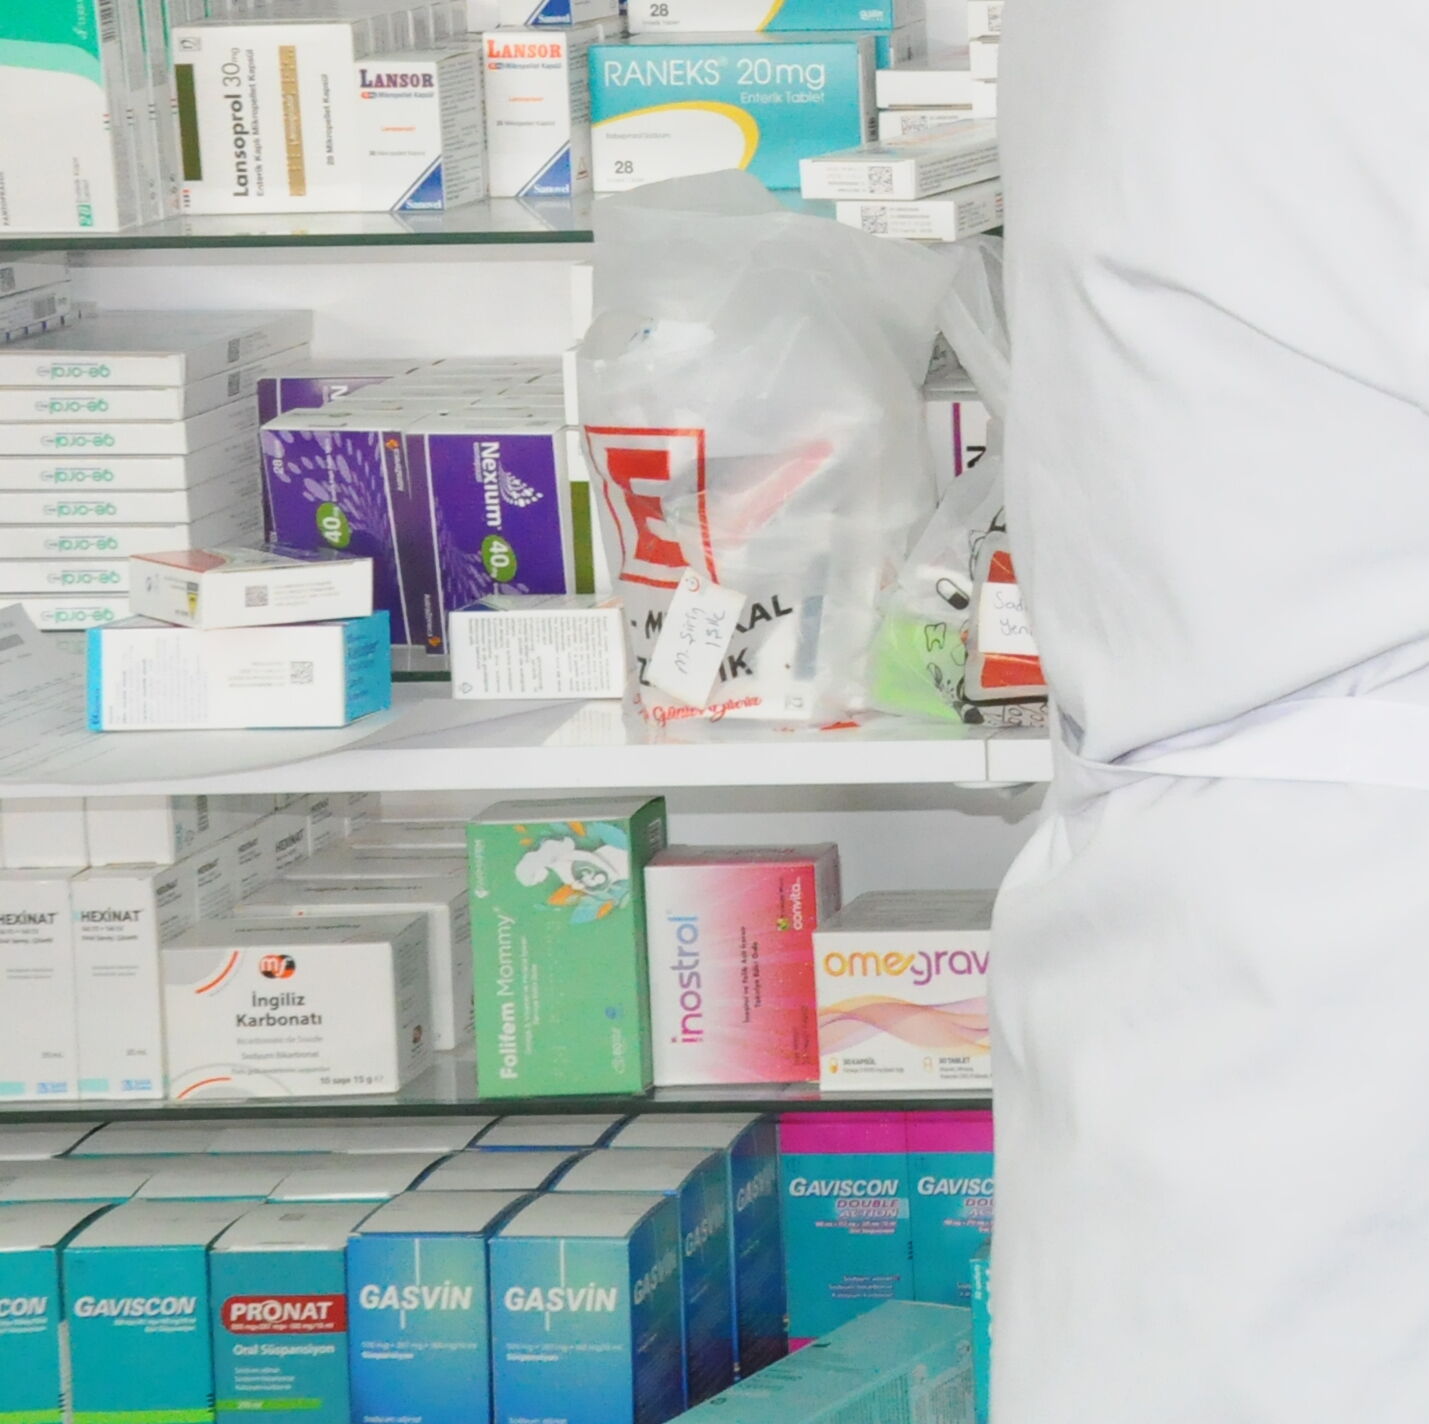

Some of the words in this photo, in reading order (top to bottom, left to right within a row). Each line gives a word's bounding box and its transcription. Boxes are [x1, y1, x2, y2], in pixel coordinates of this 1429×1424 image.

[649, 4, 669, 17] 28
[487, 39, 562, 60] LANSOR
[221, 47, 241, 89] 30mg
[359, 68, 434, 88] LANSOR
[603, 58, 721, 87] RANEKS
[737, 58, 826, 90] 20mg
[785, 91, 825, 104] Tablet
[224, 93, 249, 197] Lansoprol
[614, 159, 634, 174] 28
[479, 441, 501, 528] Nexium
[80, 909, 141, 923] HEXİNAT
[498, 914, 517, 995] Mommy
[823, 949, 989, 984] omegrav
[671, 914, 700, 1044] inostrol
[252, 990, 305, 1009] İngiliz
[236, 1012, 323, 1027] Karbonatı
[500, 1000, 517, 1079] Folifem
[789, 1178, 899, 1197] GAVISCON
[359, 1280, 473, 1310] GASVİN
[504, 1286, 618, 1313] GASVİN
[74, 1296, 197, 1317] GAVISCON
[230, 1300, 334, 1322] PRONAT
